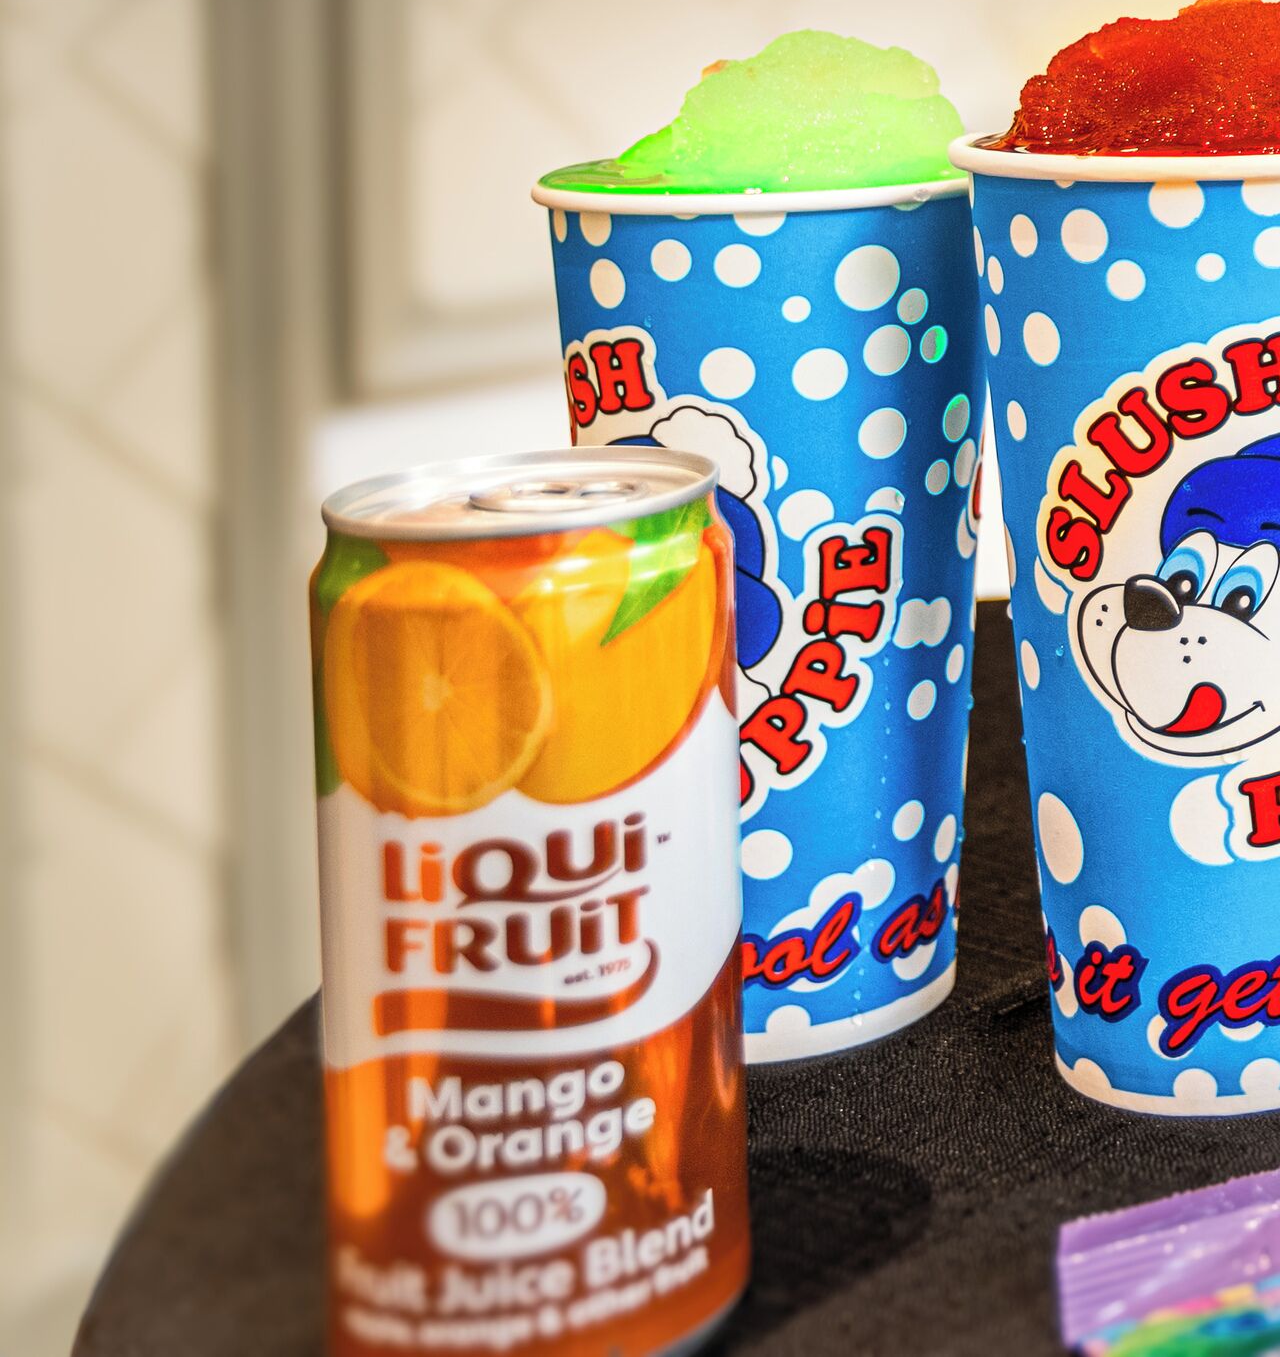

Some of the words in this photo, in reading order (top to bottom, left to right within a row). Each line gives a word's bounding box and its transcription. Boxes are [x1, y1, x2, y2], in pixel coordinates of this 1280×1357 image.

[1080, 944, 1135, 1017] it
[407, 1060, 626, 1120] Mango
[382, 1126, 417, 1174] &
[426, 1097, 657, 1174] Orange
[452, 1185, 585, 1240] 100%
[586, 1187, 715, 1288] Blend
